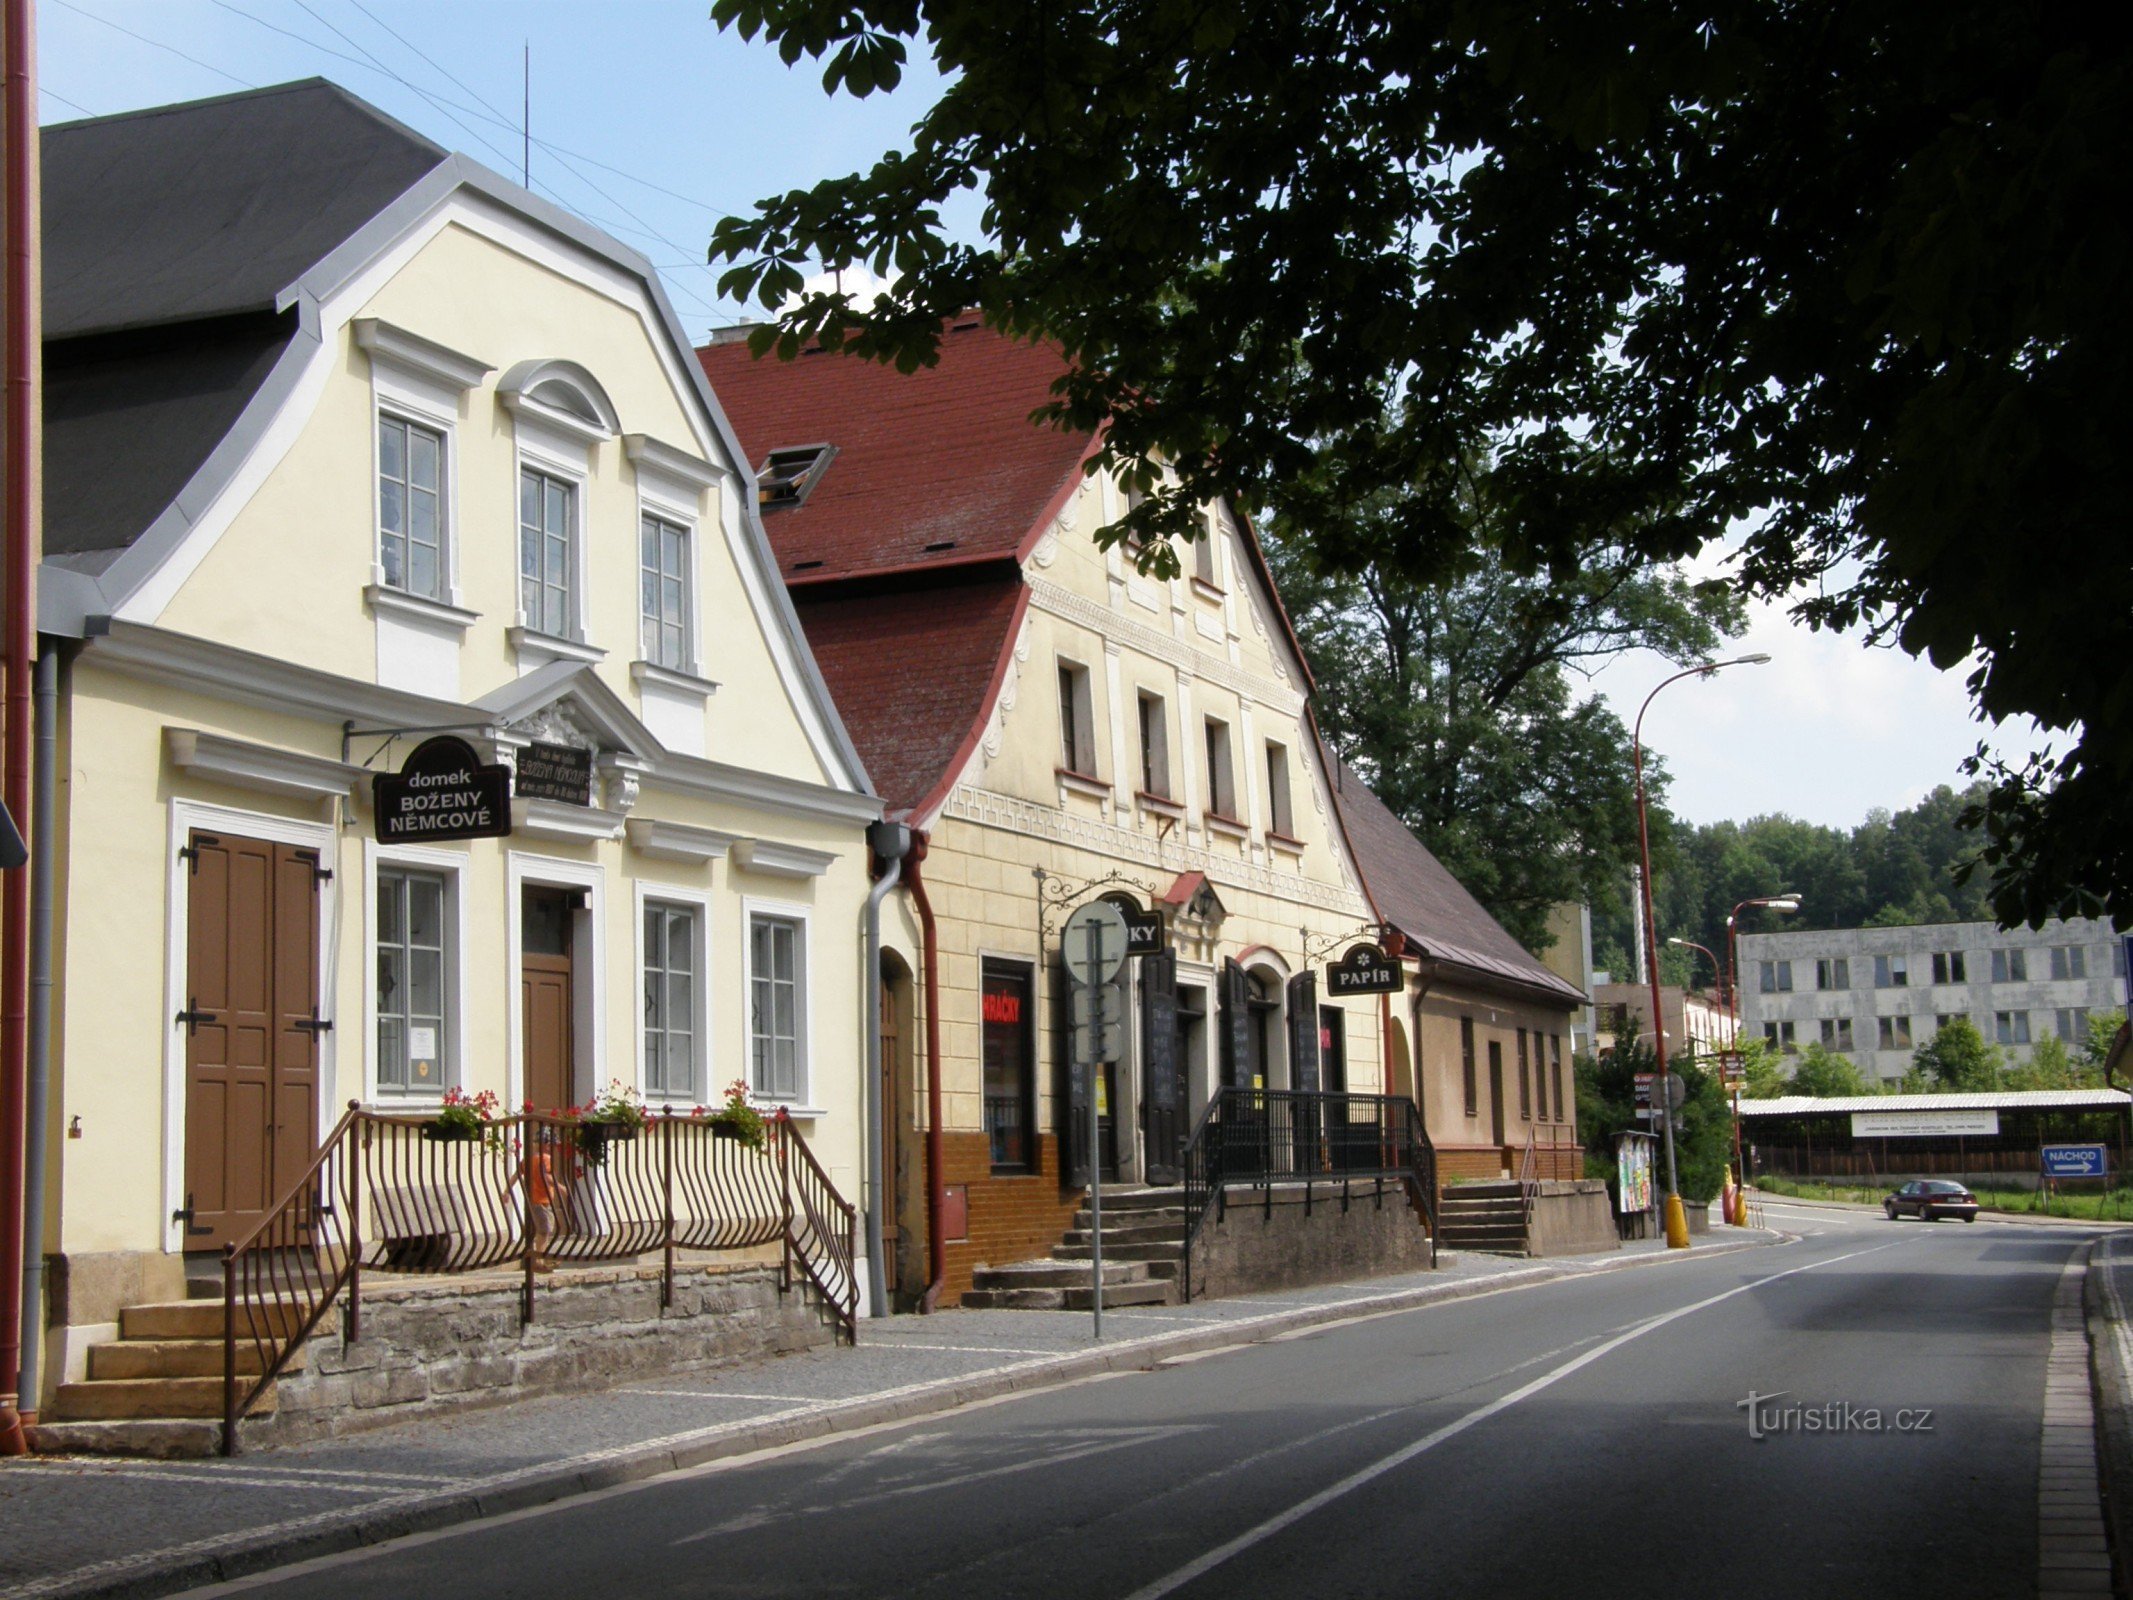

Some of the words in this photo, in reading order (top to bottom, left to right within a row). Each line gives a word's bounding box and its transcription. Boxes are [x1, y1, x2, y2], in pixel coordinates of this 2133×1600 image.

[409, 768, 471, 787] domek
[401, 791, 482, 812] BOŽENY
[390, 806, 491, 832] NĚMCOVÉ
[1130, 926, 1156, 942] KY
[1340, 969, 1391, 985] PAPÍR
[2049, 1150, 2096, 1161] NÁCHOD
